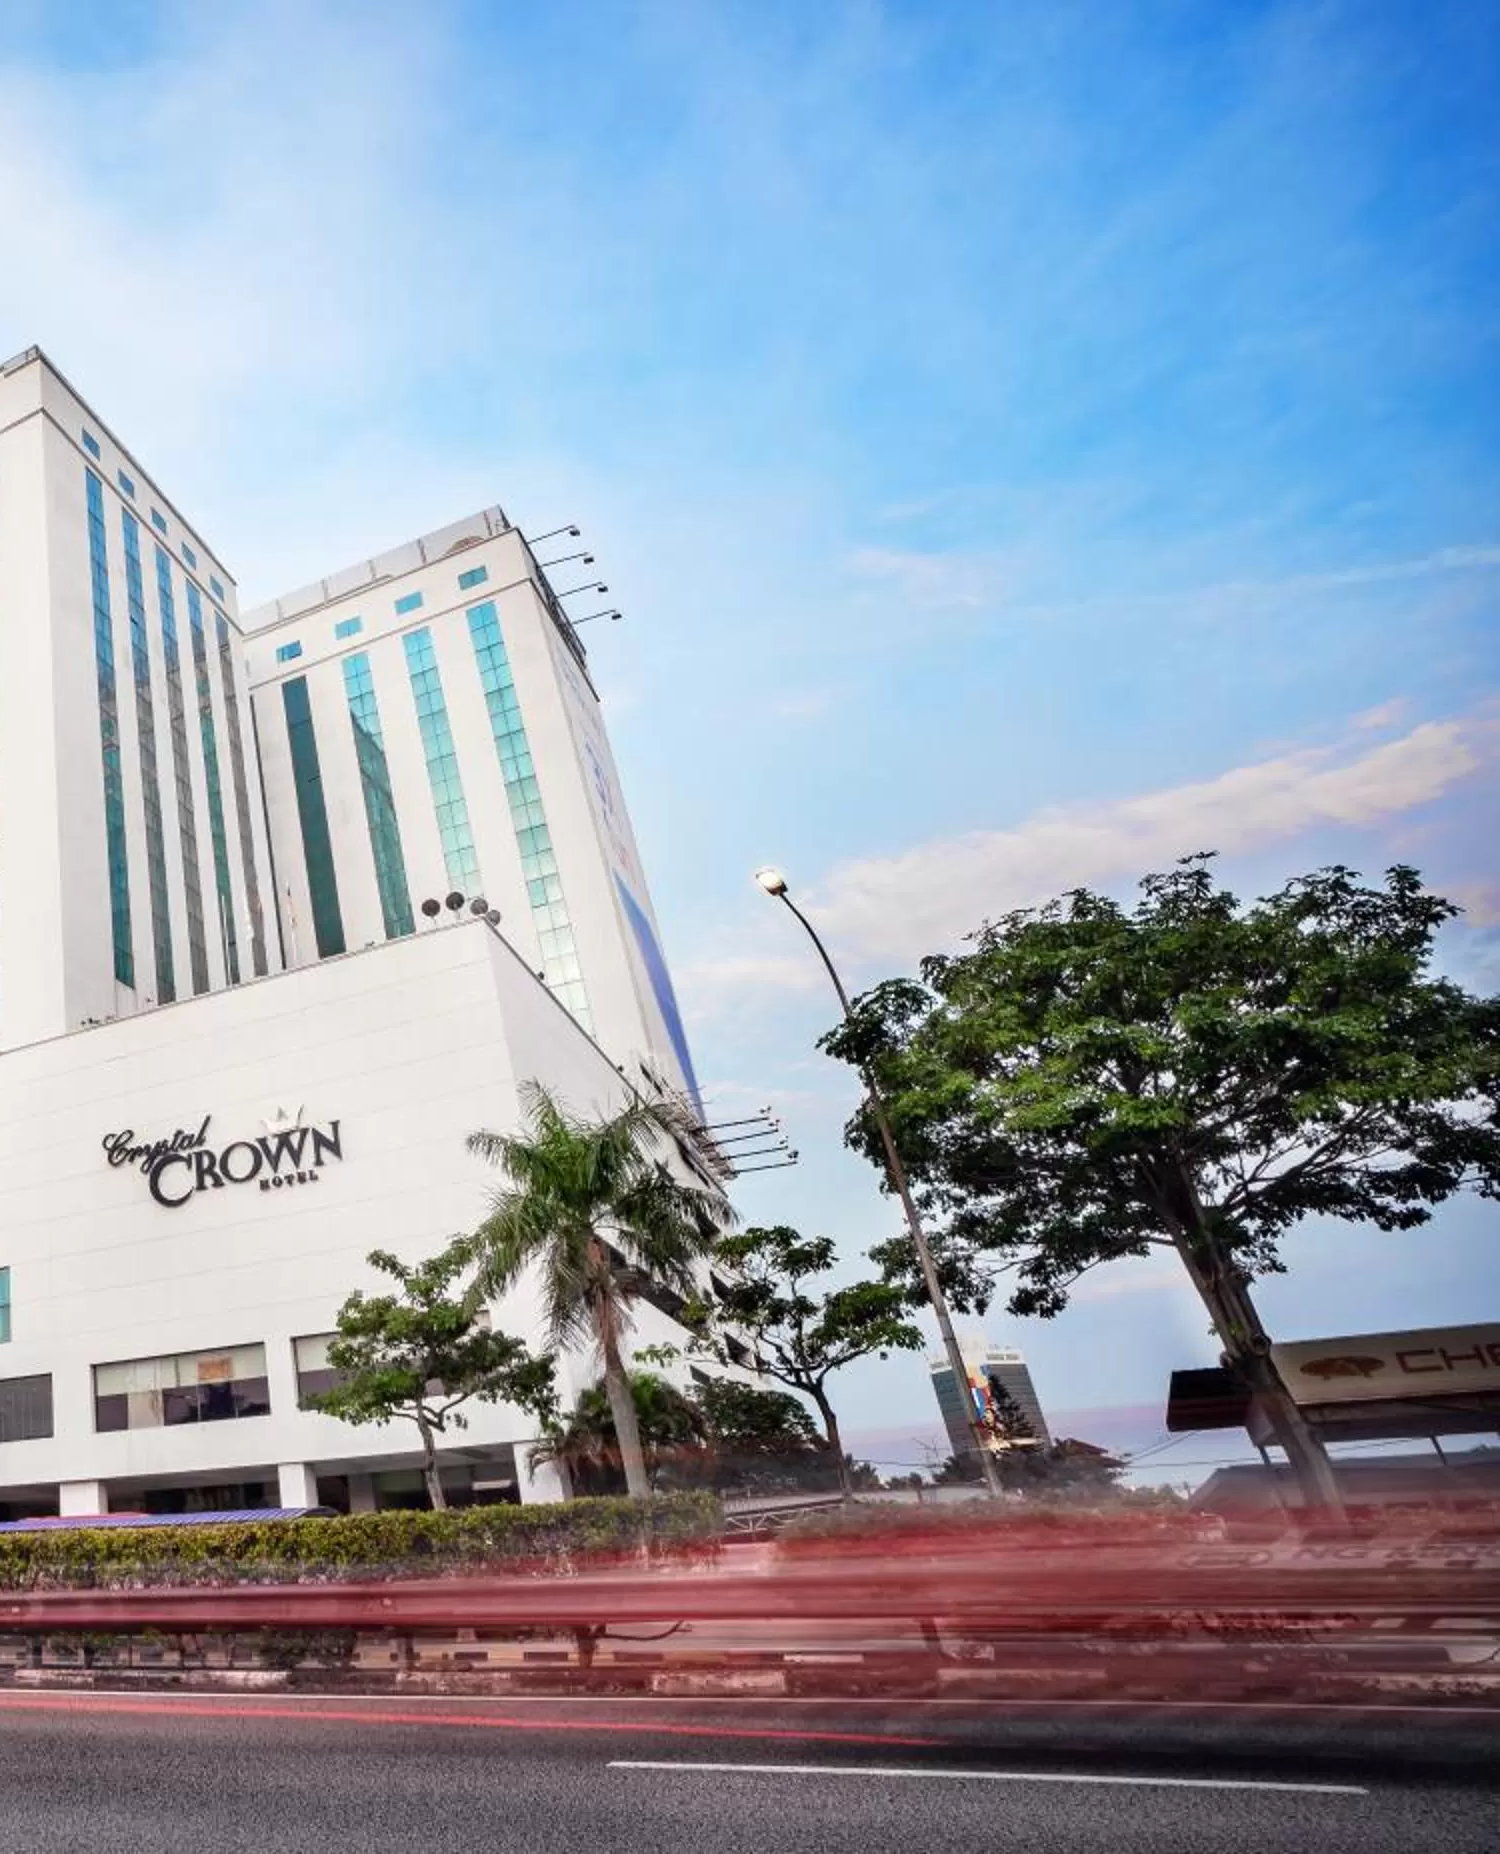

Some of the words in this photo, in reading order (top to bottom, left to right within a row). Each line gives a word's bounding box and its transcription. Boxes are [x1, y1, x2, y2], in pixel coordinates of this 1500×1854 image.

[102, 1114, 211, 1174] Crystal
[150, 1120, 343, 1208] CROWN
[259, 1169, 319, 1191] HOTEL
